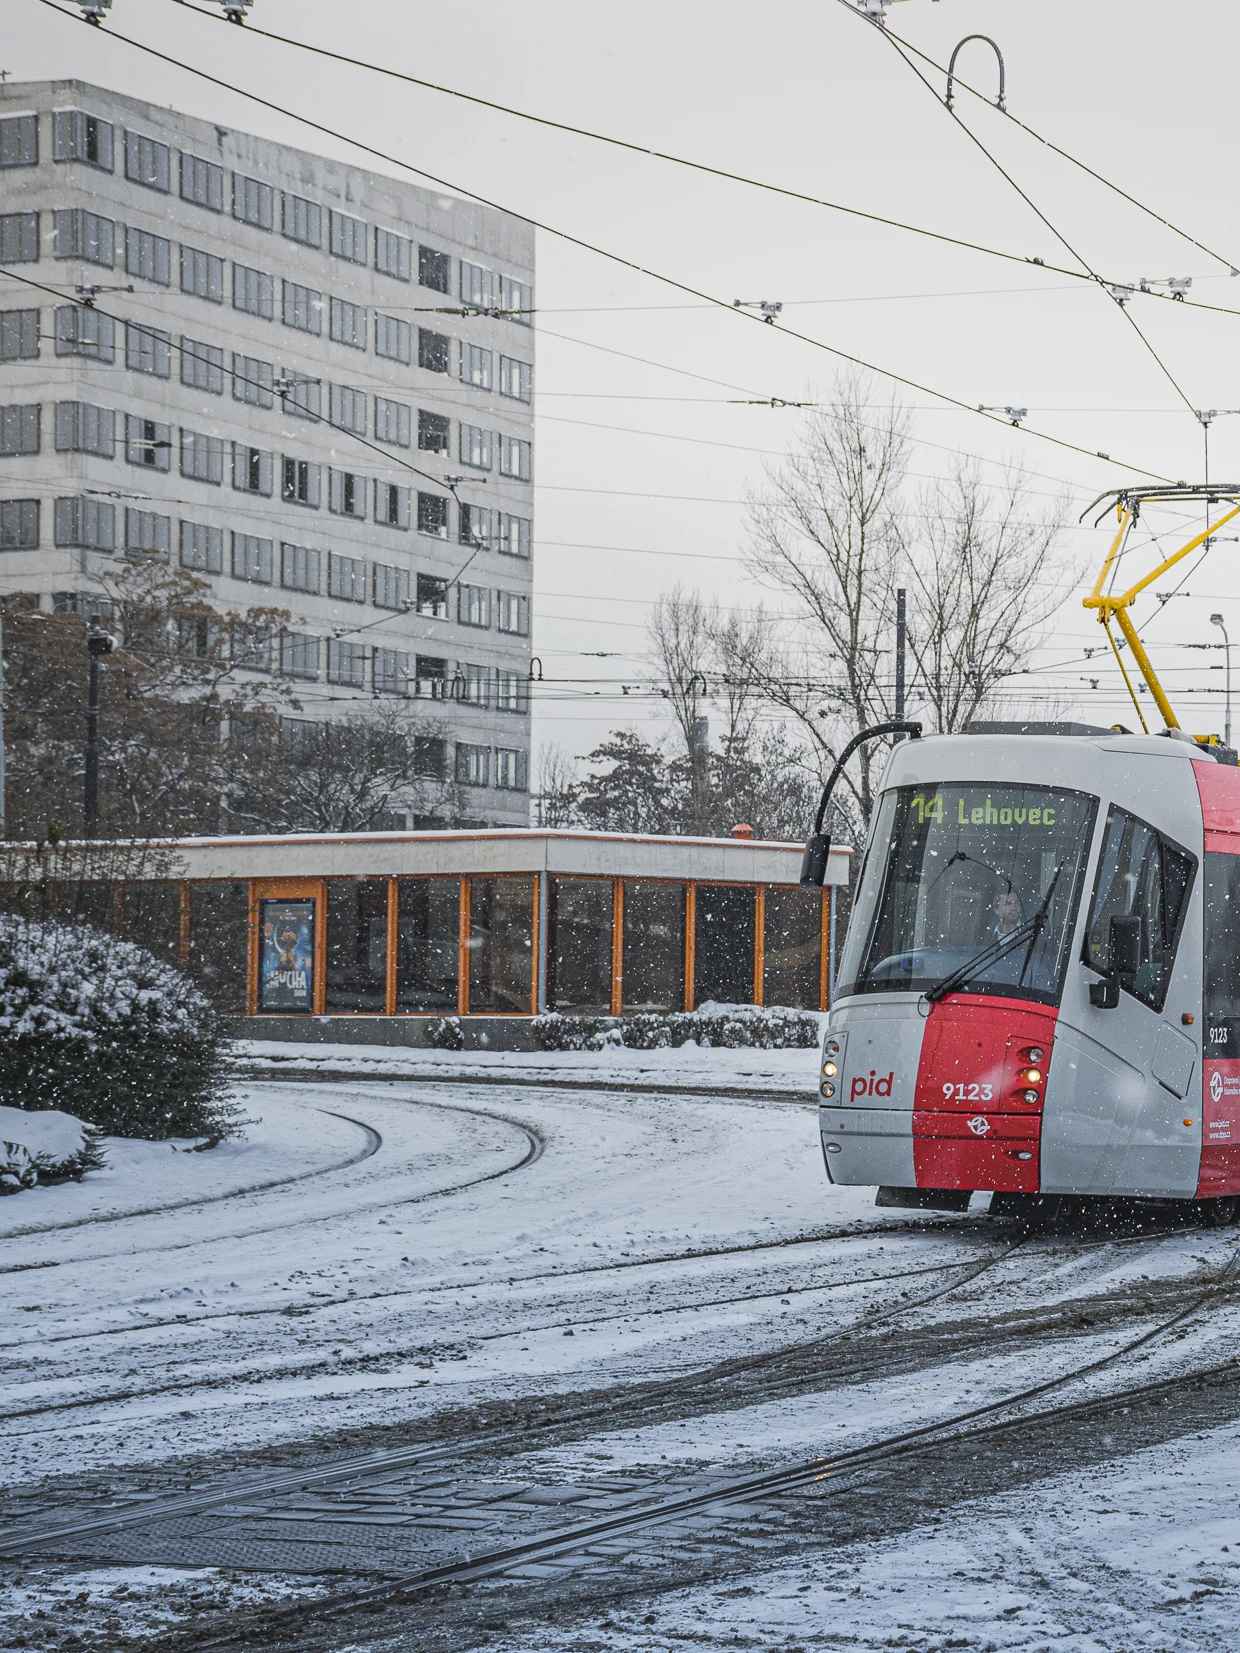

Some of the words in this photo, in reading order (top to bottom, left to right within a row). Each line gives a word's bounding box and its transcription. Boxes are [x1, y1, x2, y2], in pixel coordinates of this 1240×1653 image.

[910, 793, 944, 824] 14
[958, 798, 1056, 825] Lehovec
[1209, 1027, 1228, 1044] 9123
[849, 1069, 894, 1103] pid
[942, 1082, 993, 1101] 9123
